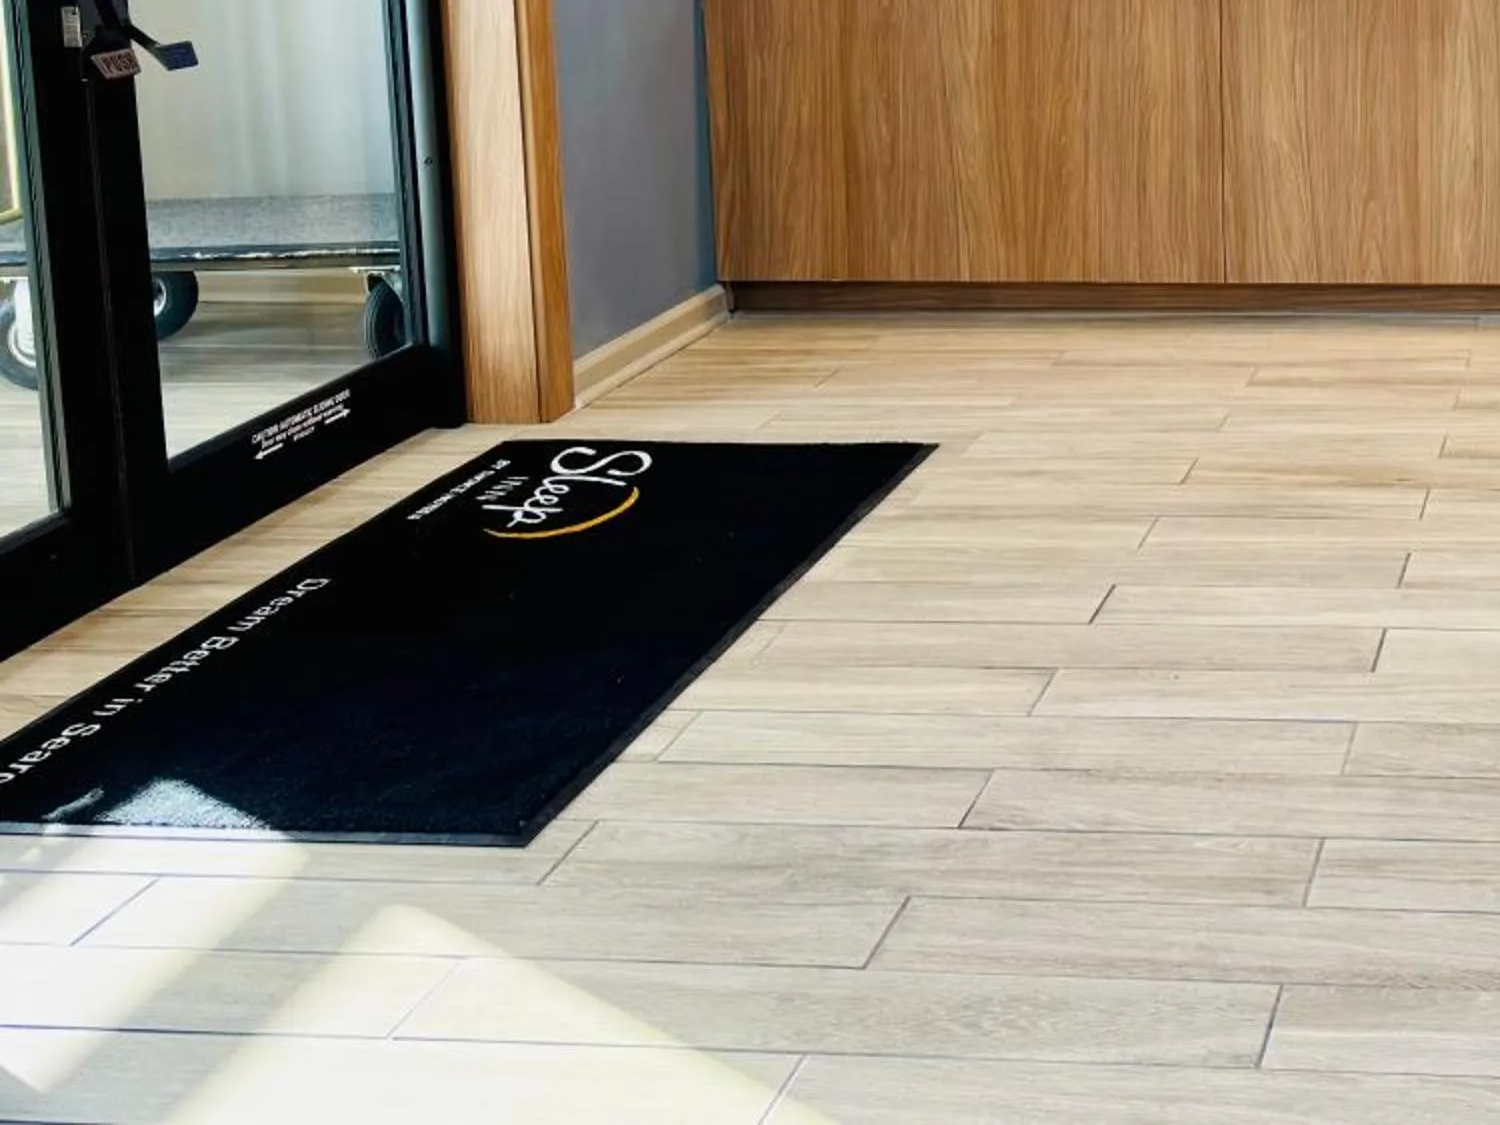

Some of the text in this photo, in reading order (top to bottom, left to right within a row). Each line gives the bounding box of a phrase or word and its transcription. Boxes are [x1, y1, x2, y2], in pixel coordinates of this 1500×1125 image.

[252, 424, 279, 444] CAUTION
[280, 407, 313, 429] AUTOMATIC
[476, 476, 529, 501] INN
[482, 446, 652, 528] Sleep
[227, 577, 331, 632] Dream
[135, 635, 240, 693] Better
[93, 697, 143, 716] in
